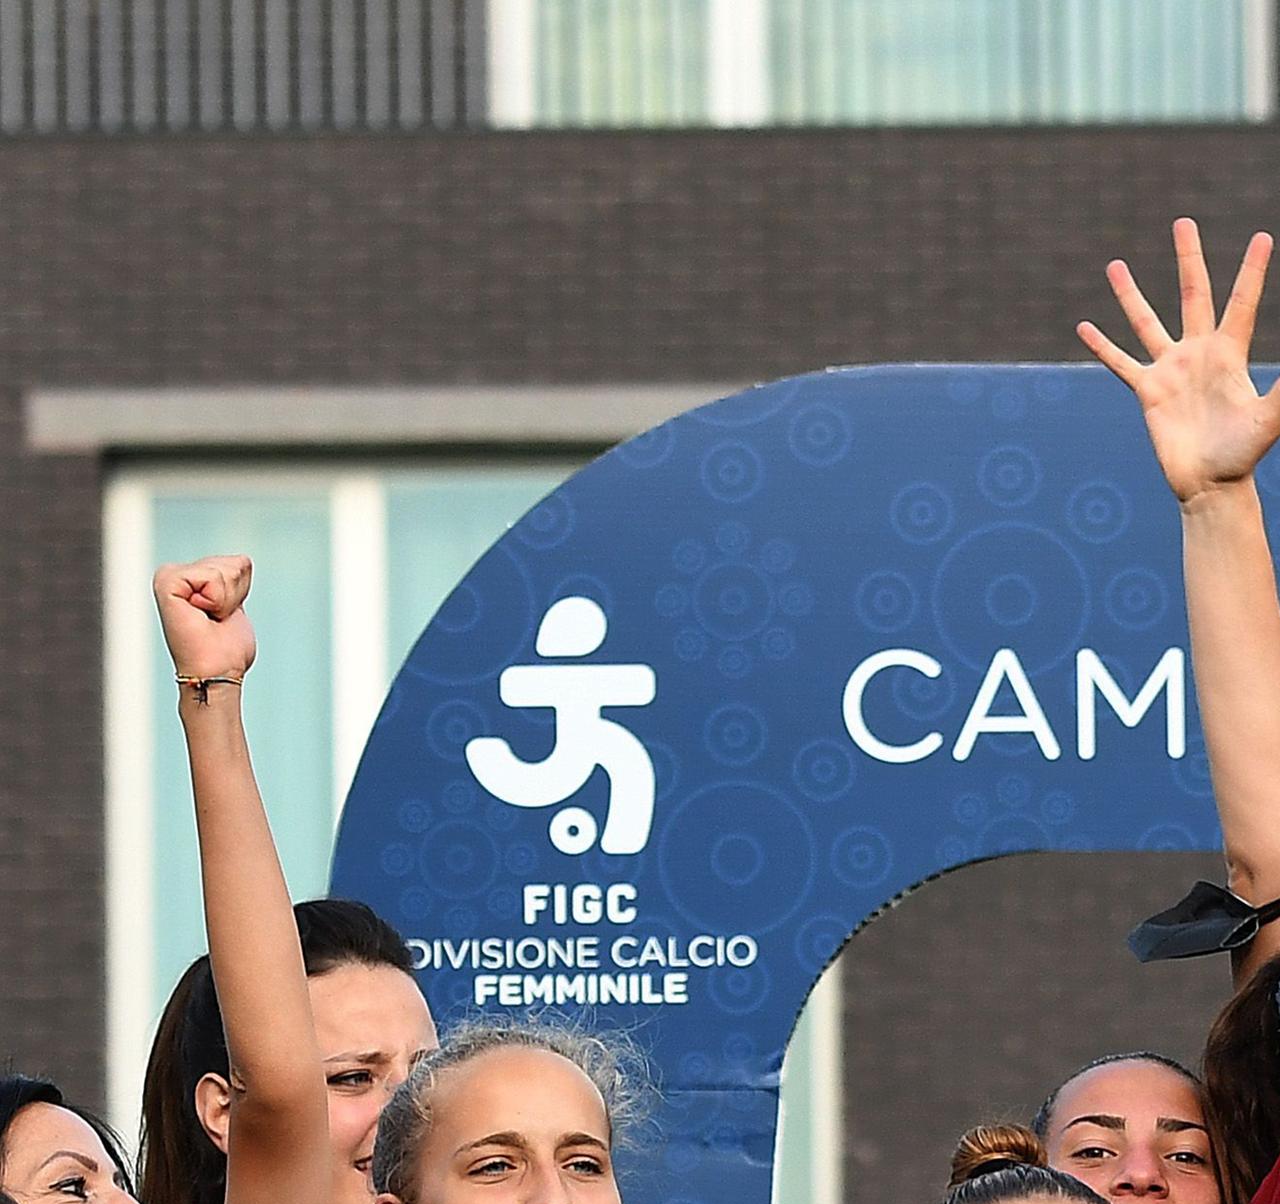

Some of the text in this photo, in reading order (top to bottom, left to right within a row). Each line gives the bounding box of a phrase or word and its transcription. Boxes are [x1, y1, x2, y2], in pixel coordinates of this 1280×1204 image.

[524, 883, 637, 924] FIGC
[611, 935, 757, 968] CALCIO
[474, 973, 688, 1006] FEMMINILE
